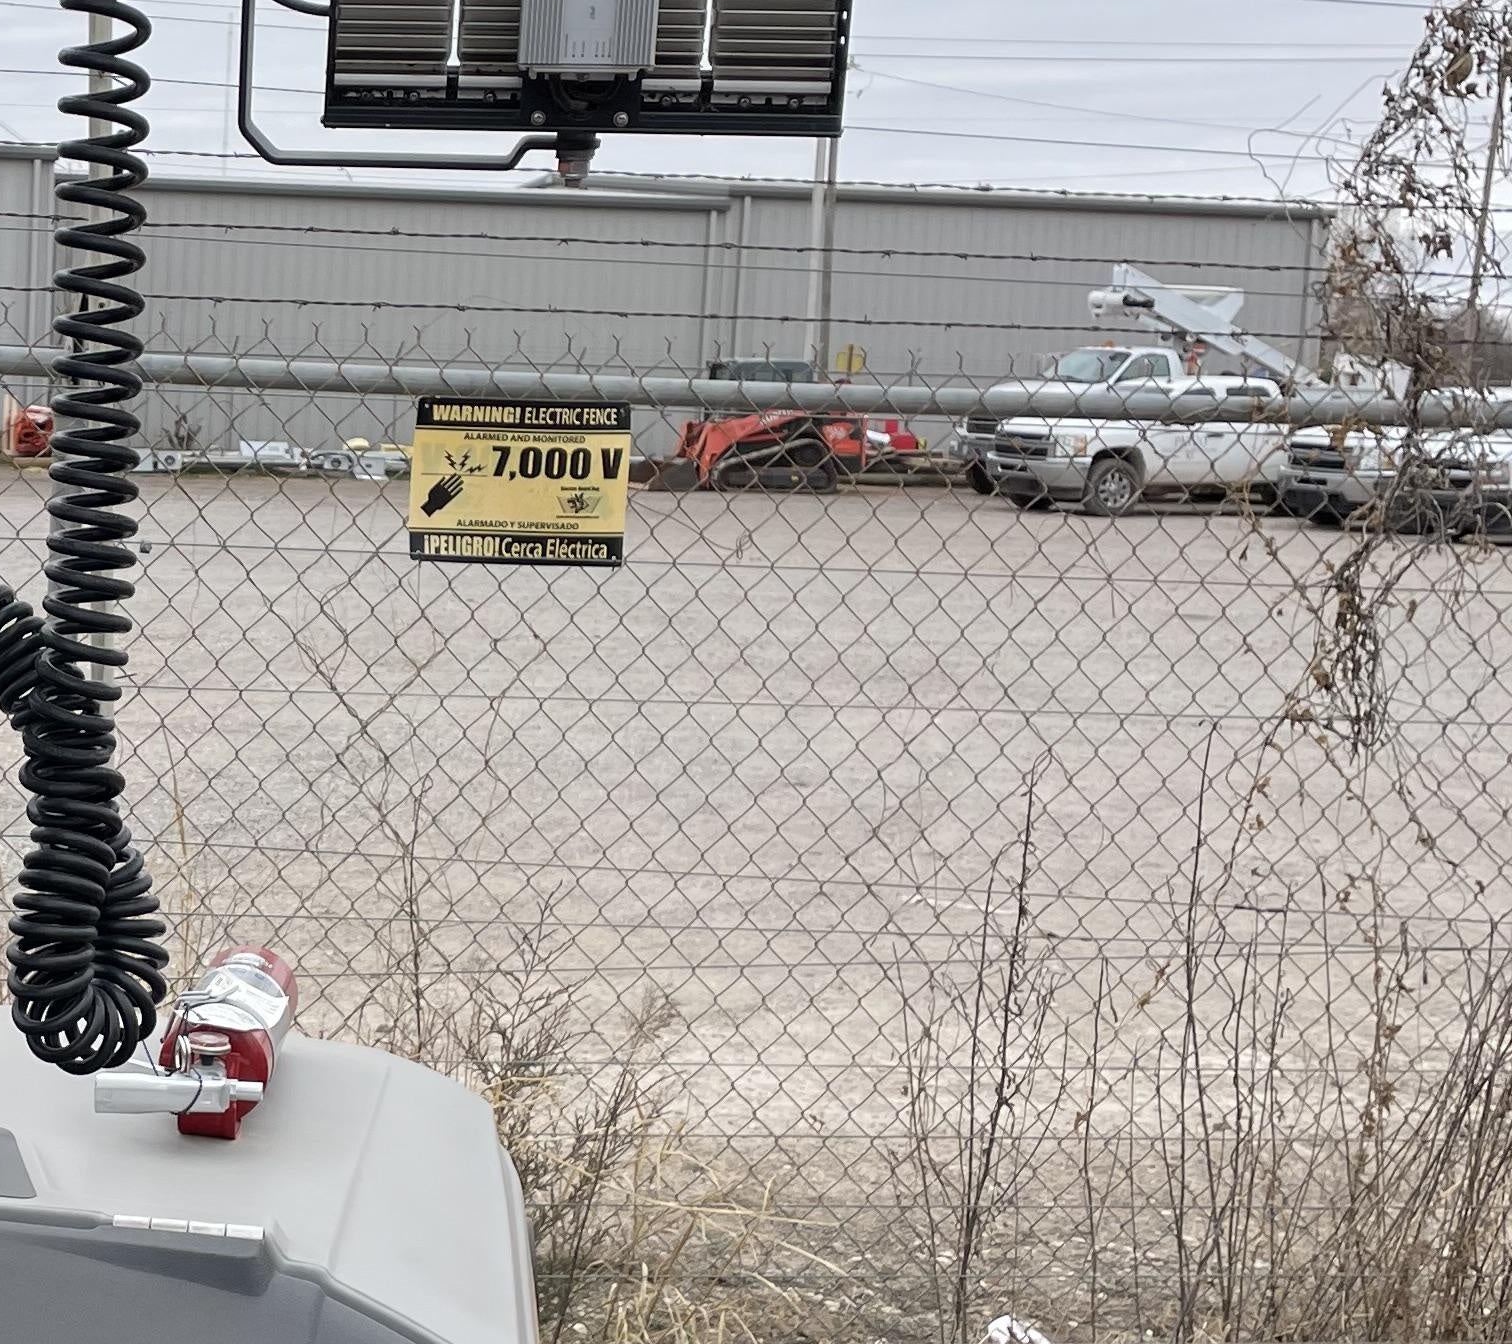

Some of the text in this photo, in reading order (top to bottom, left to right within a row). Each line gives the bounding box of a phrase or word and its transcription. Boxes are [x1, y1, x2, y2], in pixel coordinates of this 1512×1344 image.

[432, 405, 618, 425] WARNING! ELECTRIC FENCE
[464, 432, 586, 444] ALARMED AND MONITORED
[492, 445, 623, 481] 7,000 V
[456, 519, 580, 530] ALARMADO Y SUPERVISADO
[423, 534, 608, 559] ¡PELIGRO! Cerca Eléctrica
